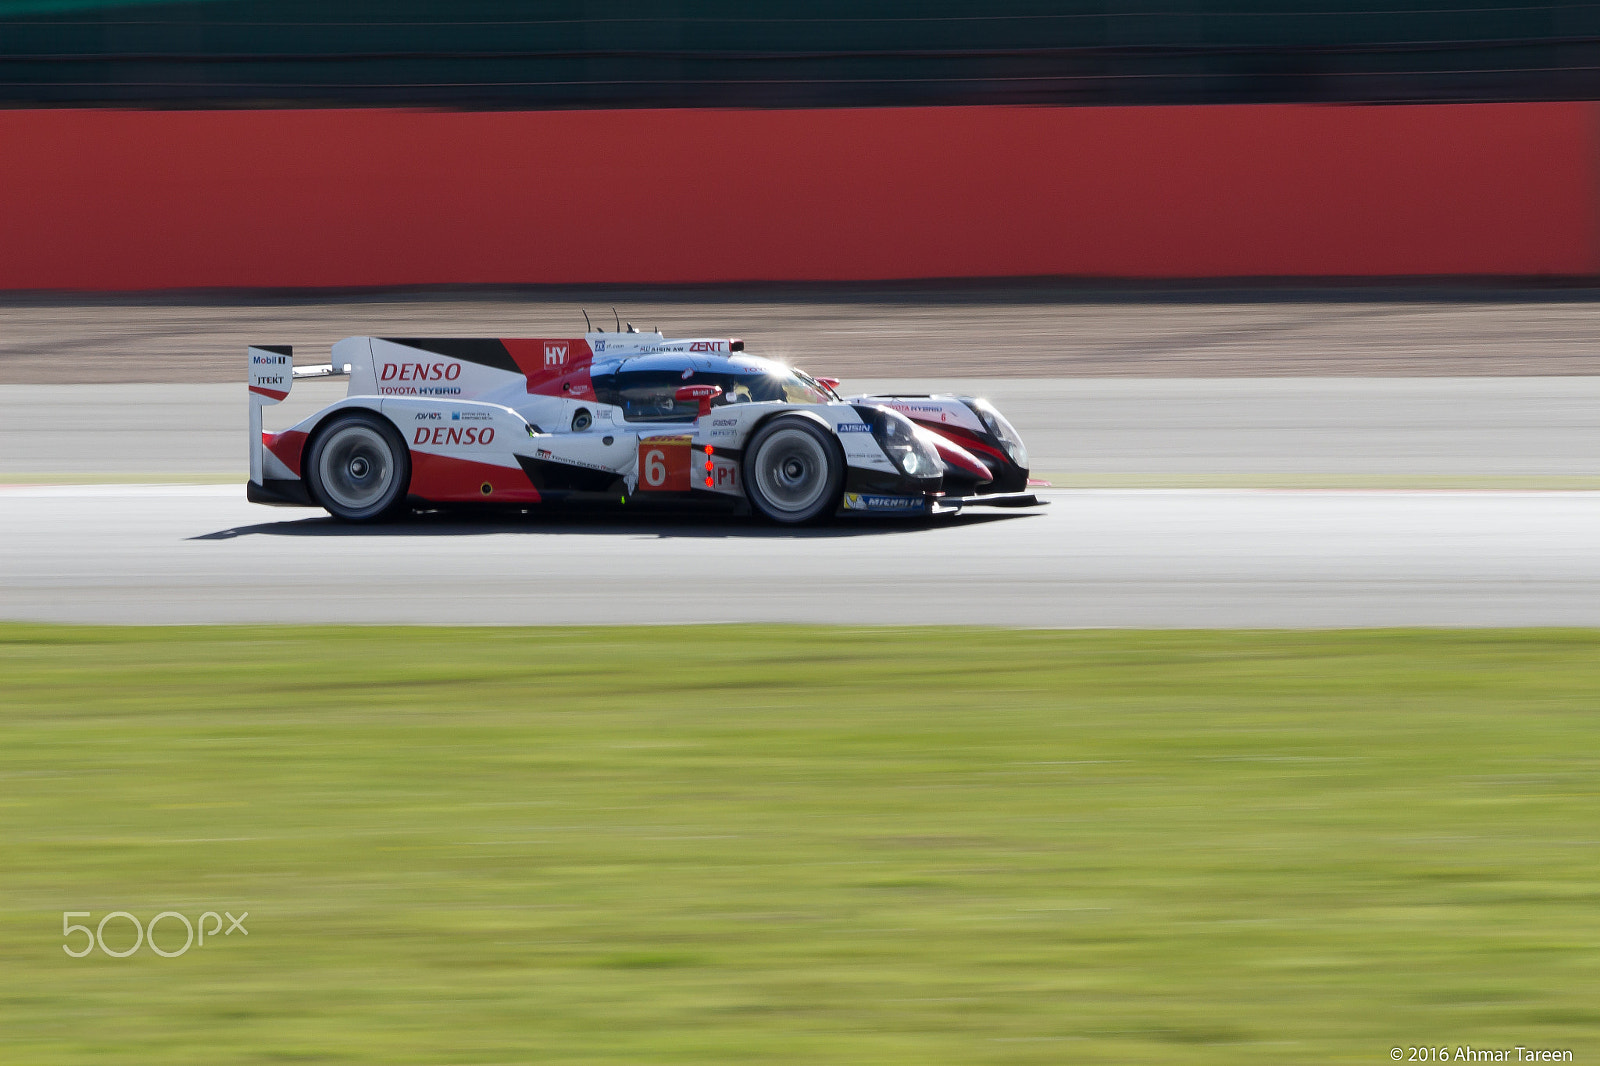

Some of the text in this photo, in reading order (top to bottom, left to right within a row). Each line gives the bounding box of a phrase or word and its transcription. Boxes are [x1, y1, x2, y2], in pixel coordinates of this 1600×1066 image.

[689, 341, 724, 352] ZENT
[253, 356, 277, 365] Mobil
[546, 347, 567, 365] HY
[381, 363, 462, 381] DENSO
[257, 376, 284, 386] JTEKT
[381, 387, 462, 395] TOYOTA HYBRID
[413, 427, 495, 445] DENSO
[645, 449, 666, 487] 6
[717, 467, 736, 486] P1
[868, 497, 923, 507] MICHELIN
